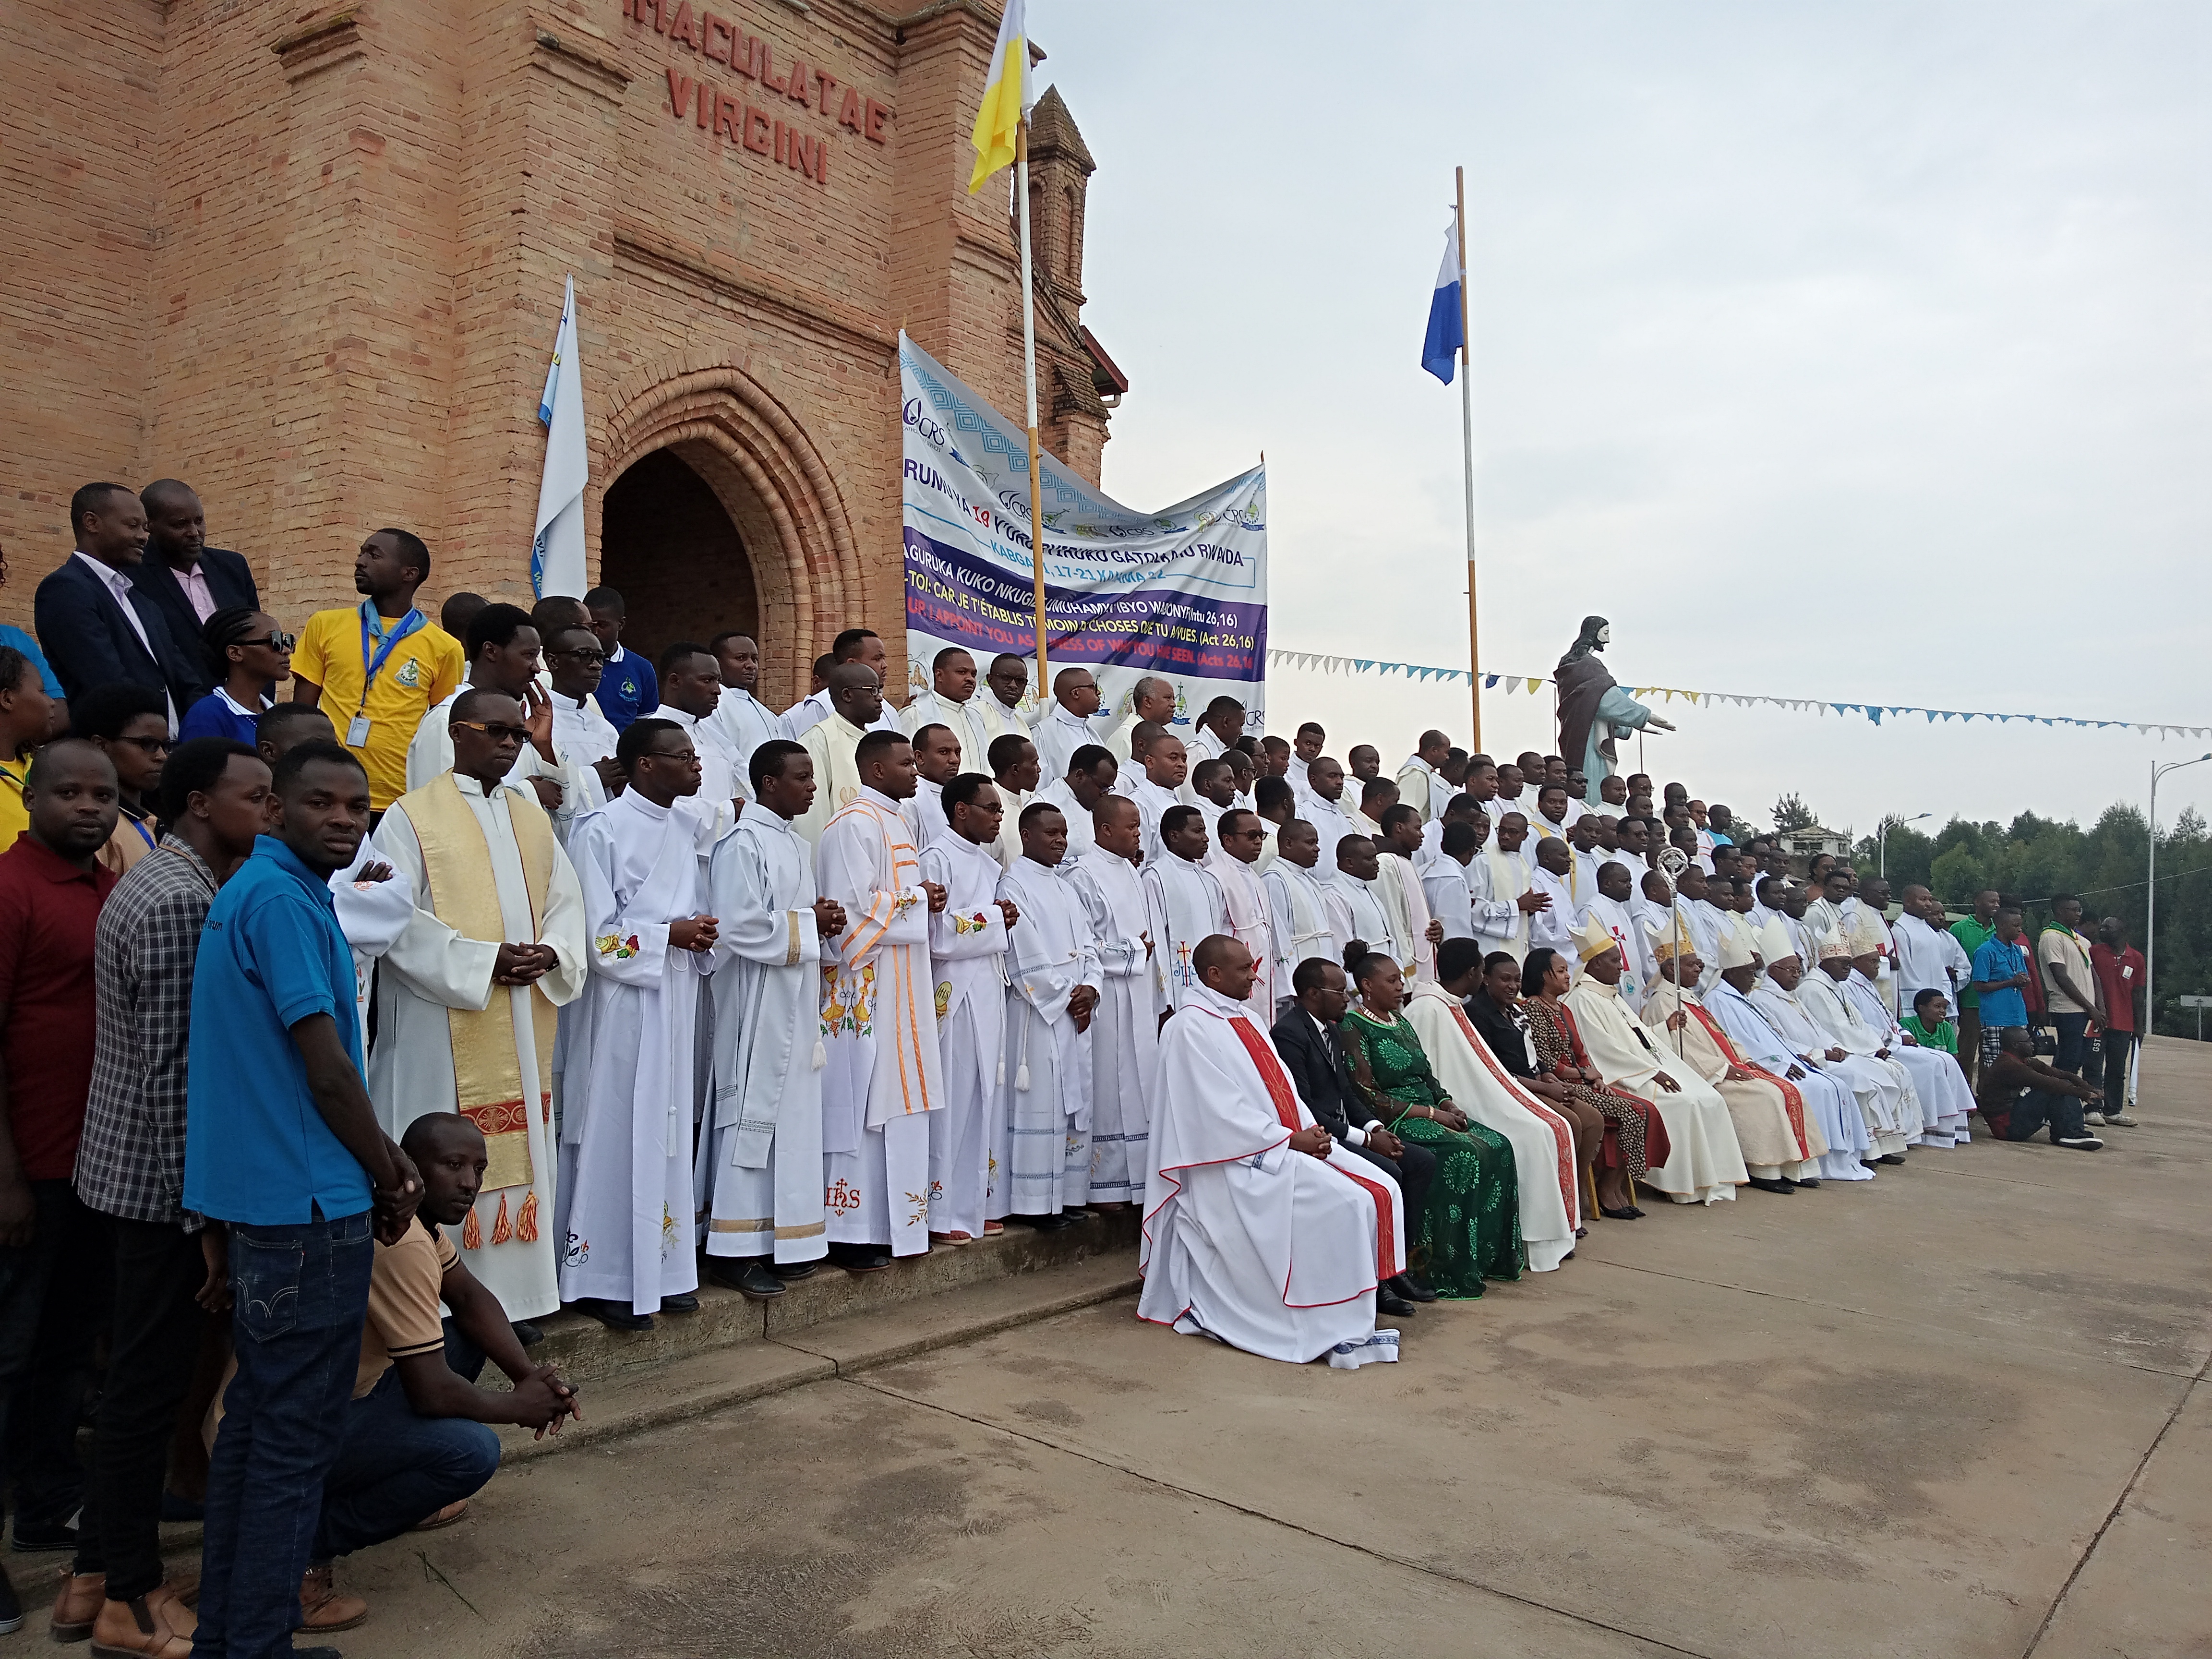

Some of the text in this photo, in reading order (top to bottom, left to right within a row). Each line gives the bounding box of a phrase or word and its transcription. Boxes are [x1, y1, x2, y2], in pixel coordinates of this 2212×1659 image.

[623, 0, 889, 145] MACULATAE
[666, 68, 827, 185] VIRGINI
[918, 418, 945, 446] CRS
[973, 506, 990, 528] 19
[956, 566, 996, 593] KUKO
[1206, 611, 1238, 629] 26,16)
[1054, 565, 1096, 581] 17-21
[933, 607, 984, 637] APPOINT
[986, 625, 1014, 645] YOU
[1017, 634, 1036, 648] AS
[1086, 638, 1106, 651] OF
[1198, 651, 1224, 667] (Acts
[934, 581, 956, 604] CAR
[958, 592, 970, 610] JE
[971, 596, 1024, 626] T'ÉTABLIS
[1155, 623, 1169, 638] TU
[1200, 631, 1220, 647] (Act
[1222, 633, 1255, 651] 26,16)
[2092, 1038, 2102, 1052] GST
